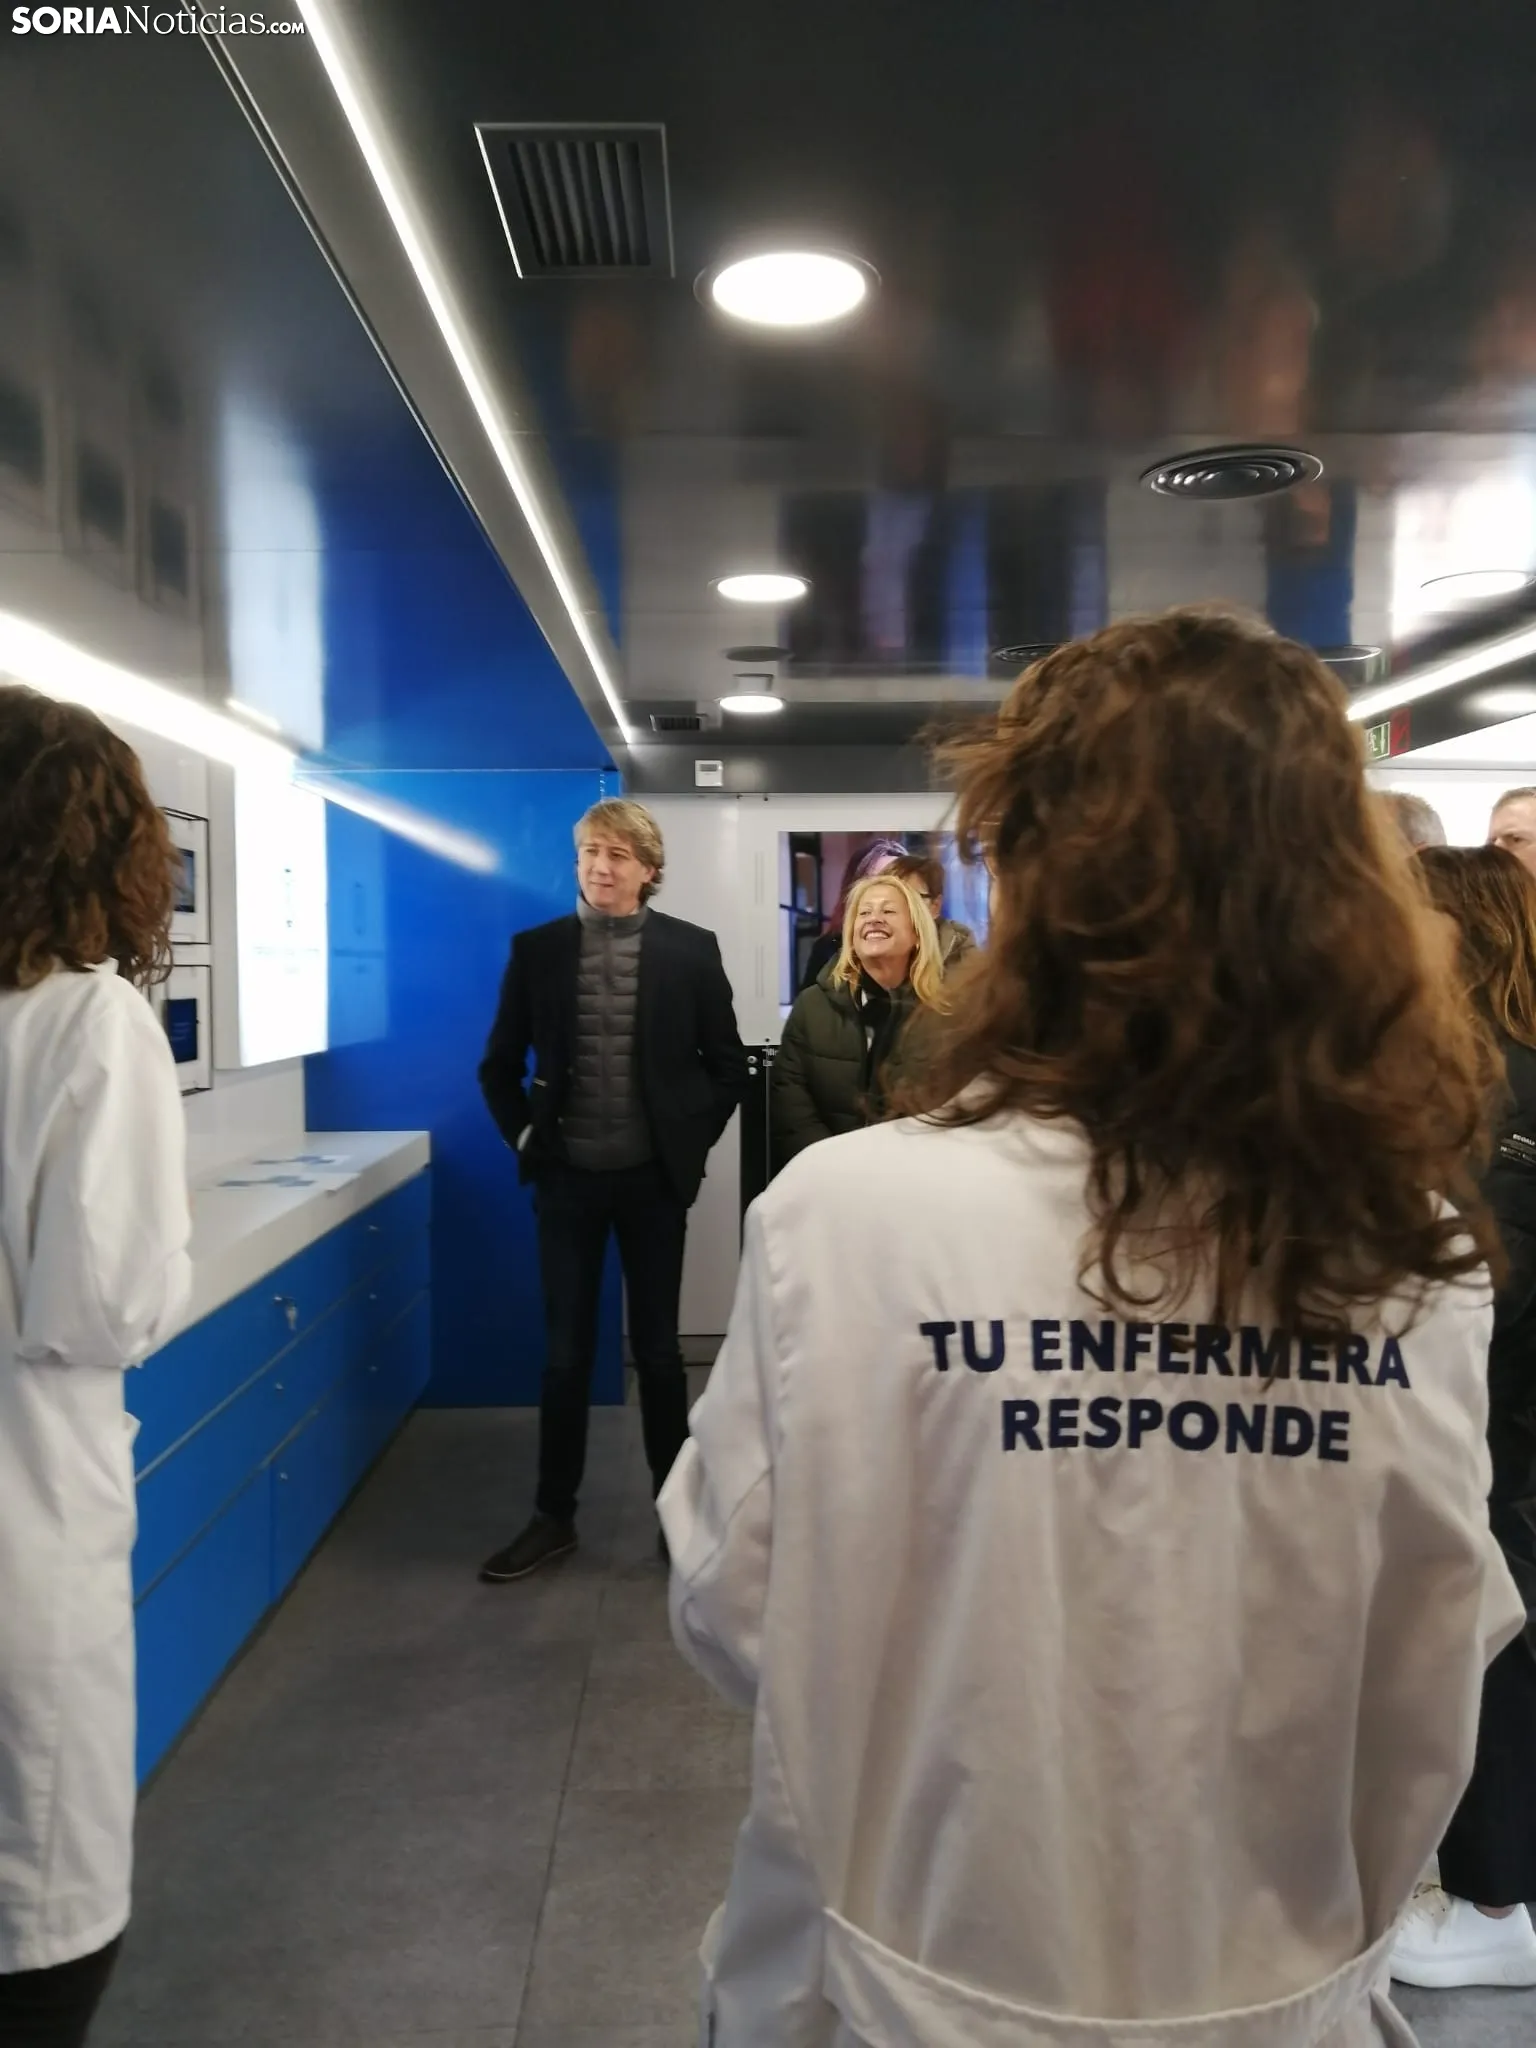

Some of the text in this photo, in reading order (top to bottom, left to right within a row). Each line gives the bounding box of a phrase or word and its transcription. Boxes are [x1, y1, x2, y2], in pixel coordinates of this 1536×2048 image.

[920, 1319, 1411, 1389] TU ENFERMERA
[1002, 1396, 1350, 1462] RESPONDE
